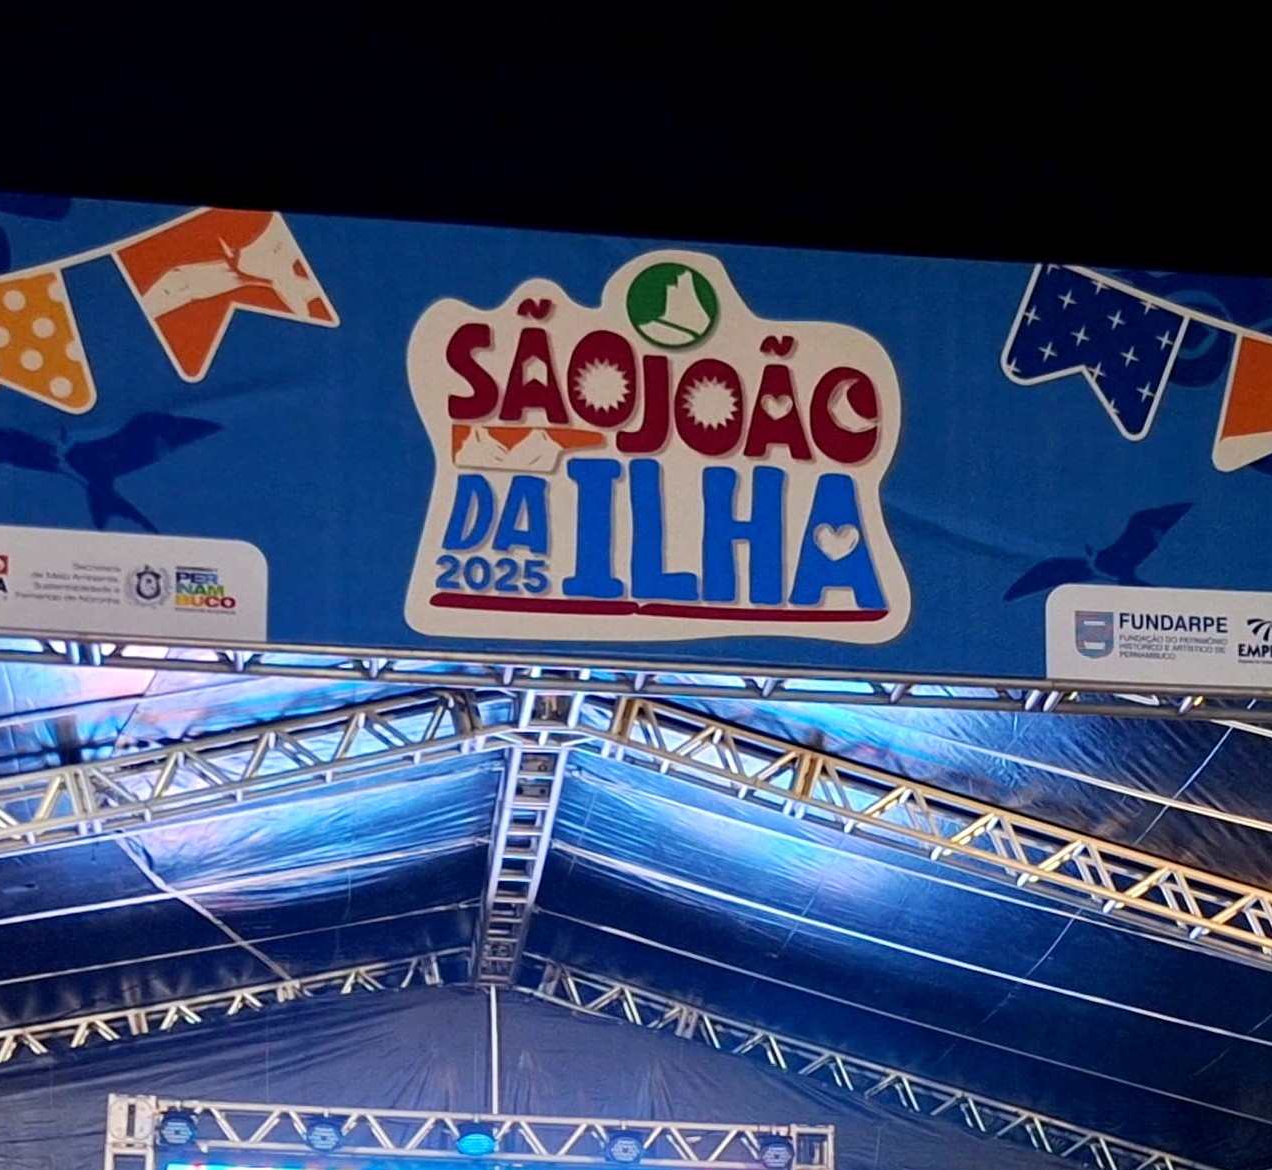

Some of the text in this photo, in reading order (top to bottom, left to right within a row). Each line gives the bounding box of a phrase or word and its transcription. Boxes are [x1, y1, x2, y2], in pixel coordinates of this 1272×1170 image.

[442, 458, 889, 610] DA ILHA
[176, 571, 218, 585] PER
[435, 555, 550, 594] 2025
[1119, 613, 1228, 633] FUNDARPE
